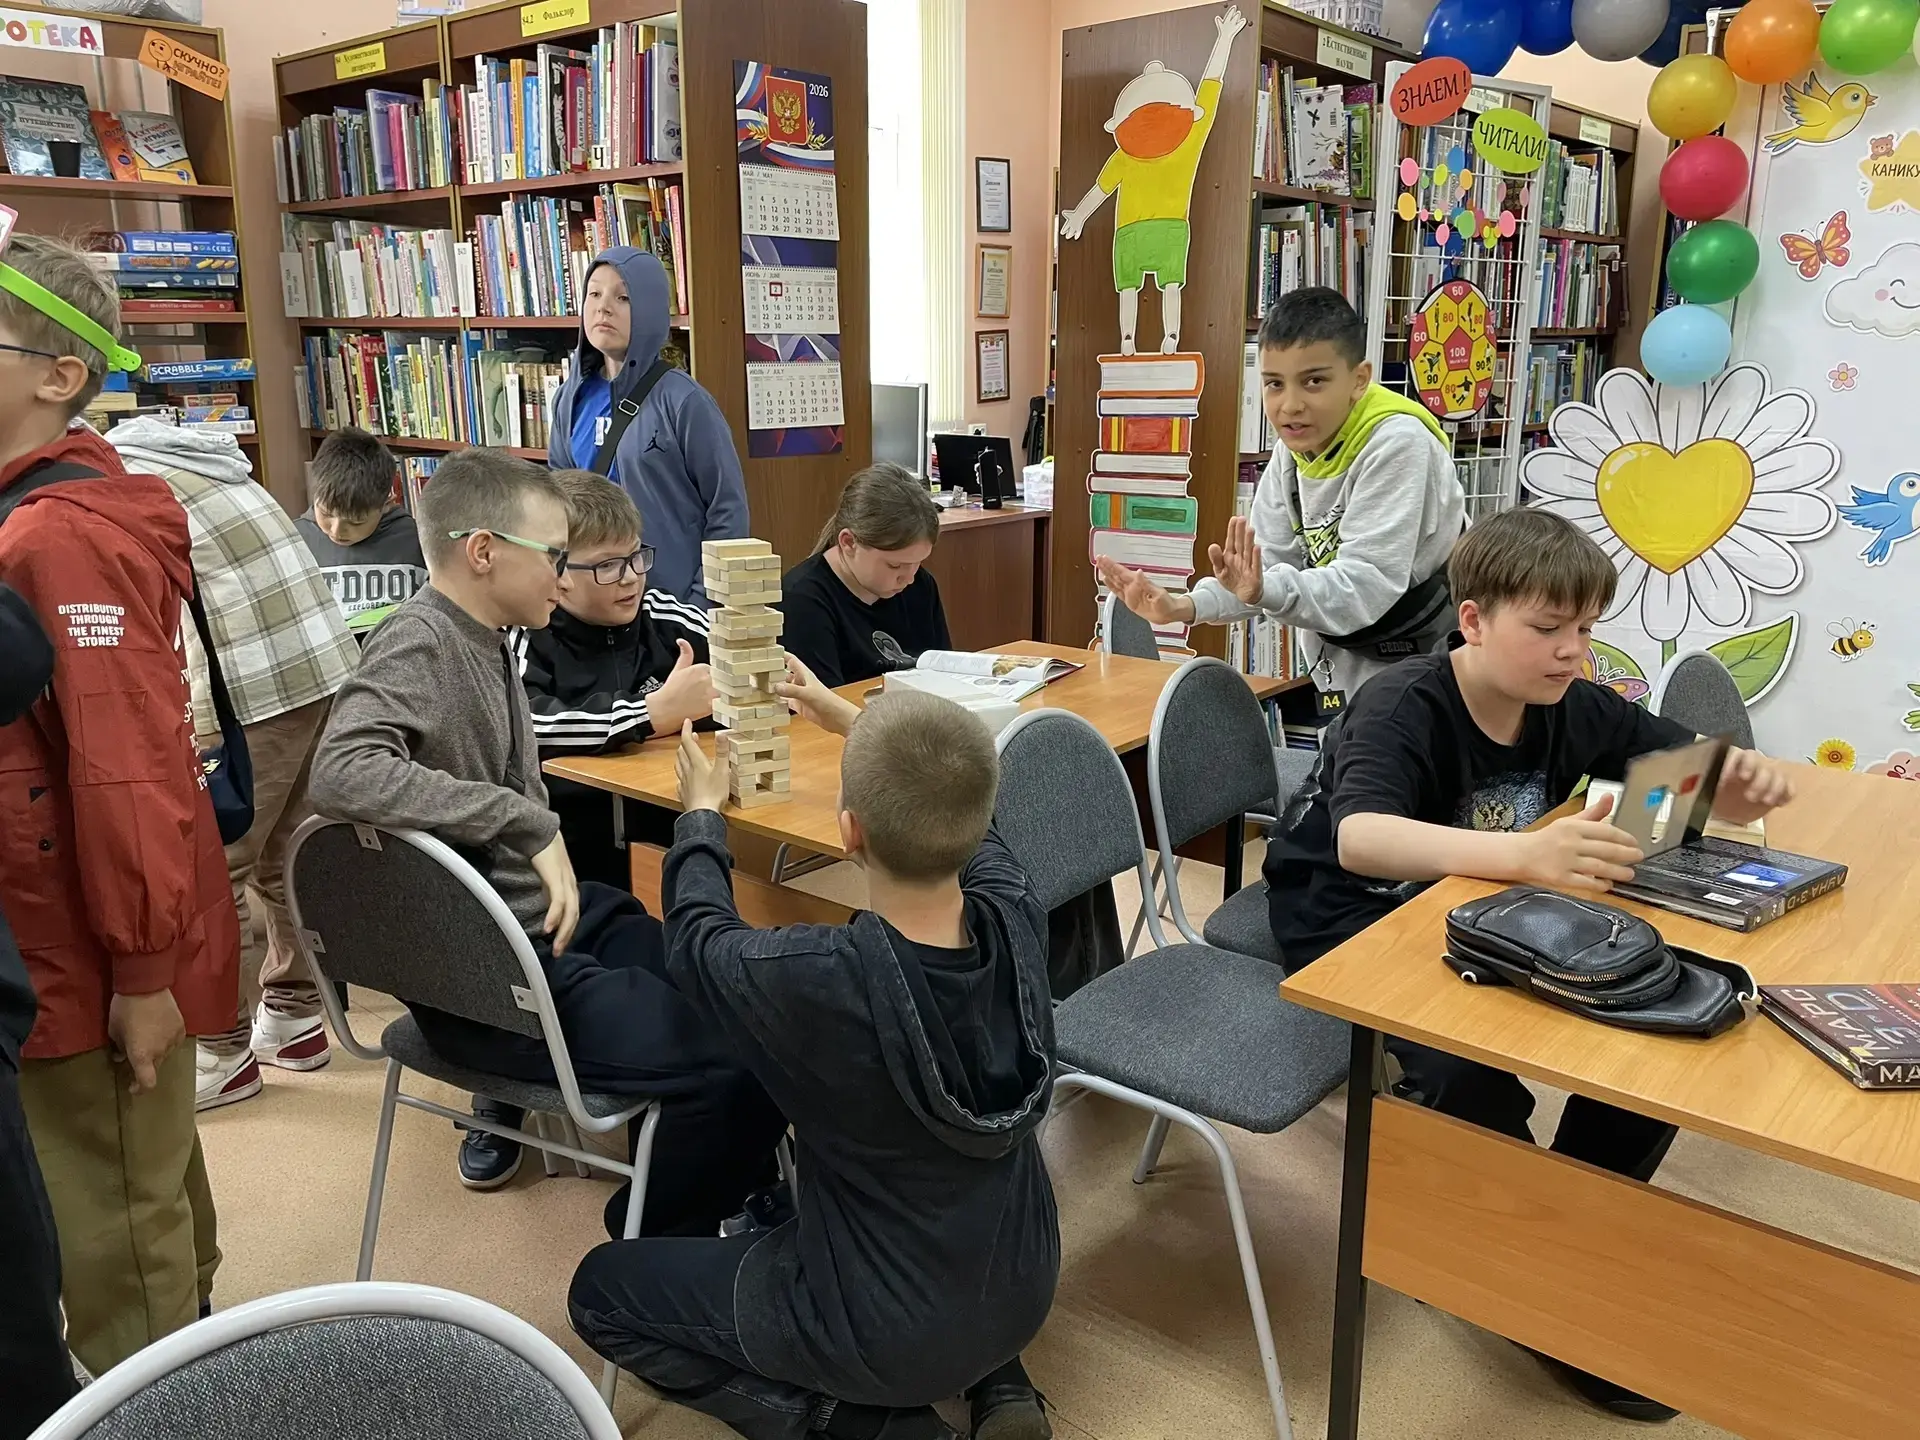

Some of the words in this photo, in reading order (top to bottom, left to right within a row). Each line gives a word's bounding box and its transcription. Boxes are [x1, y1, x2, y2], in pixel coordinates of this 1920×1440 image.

[173, 47, 225, 77] СКУЧНО?
[173, 60, 222, 90] ИГРАЙТЕ!
[809, 84, 829, 98] 2026
[1479, 121, 1547, 162] ЧИТАЛИ!
[1452, 286, 1463, 295] 60
[1443, 313, 1453, 322] 80
[1414, 332, 1426, 342] 60
[1450, 348, 1465, 356] 100
[151, 364, 202, 376] SCRABBLE
[1476, 361, 1485, 370] 90
[1427, 375, 1438, 384] 90
[1445, 385, 1455, 394] 80
[1428, 397, 1439, 406] 70
[57, 603, 125, 616] DISTRIBUTED
[69, 614, 120, 625] THROUGH
[67, 626, 88, 637] THE
[90, 626, 125, 637] FINEST
[77, 636, 120, 647] STORES
[1323, 695, 1340, 708] A4
[1811, 872, 1845, 893] ЛУНА
[1780, 988, 1890, 1050] МАРС
